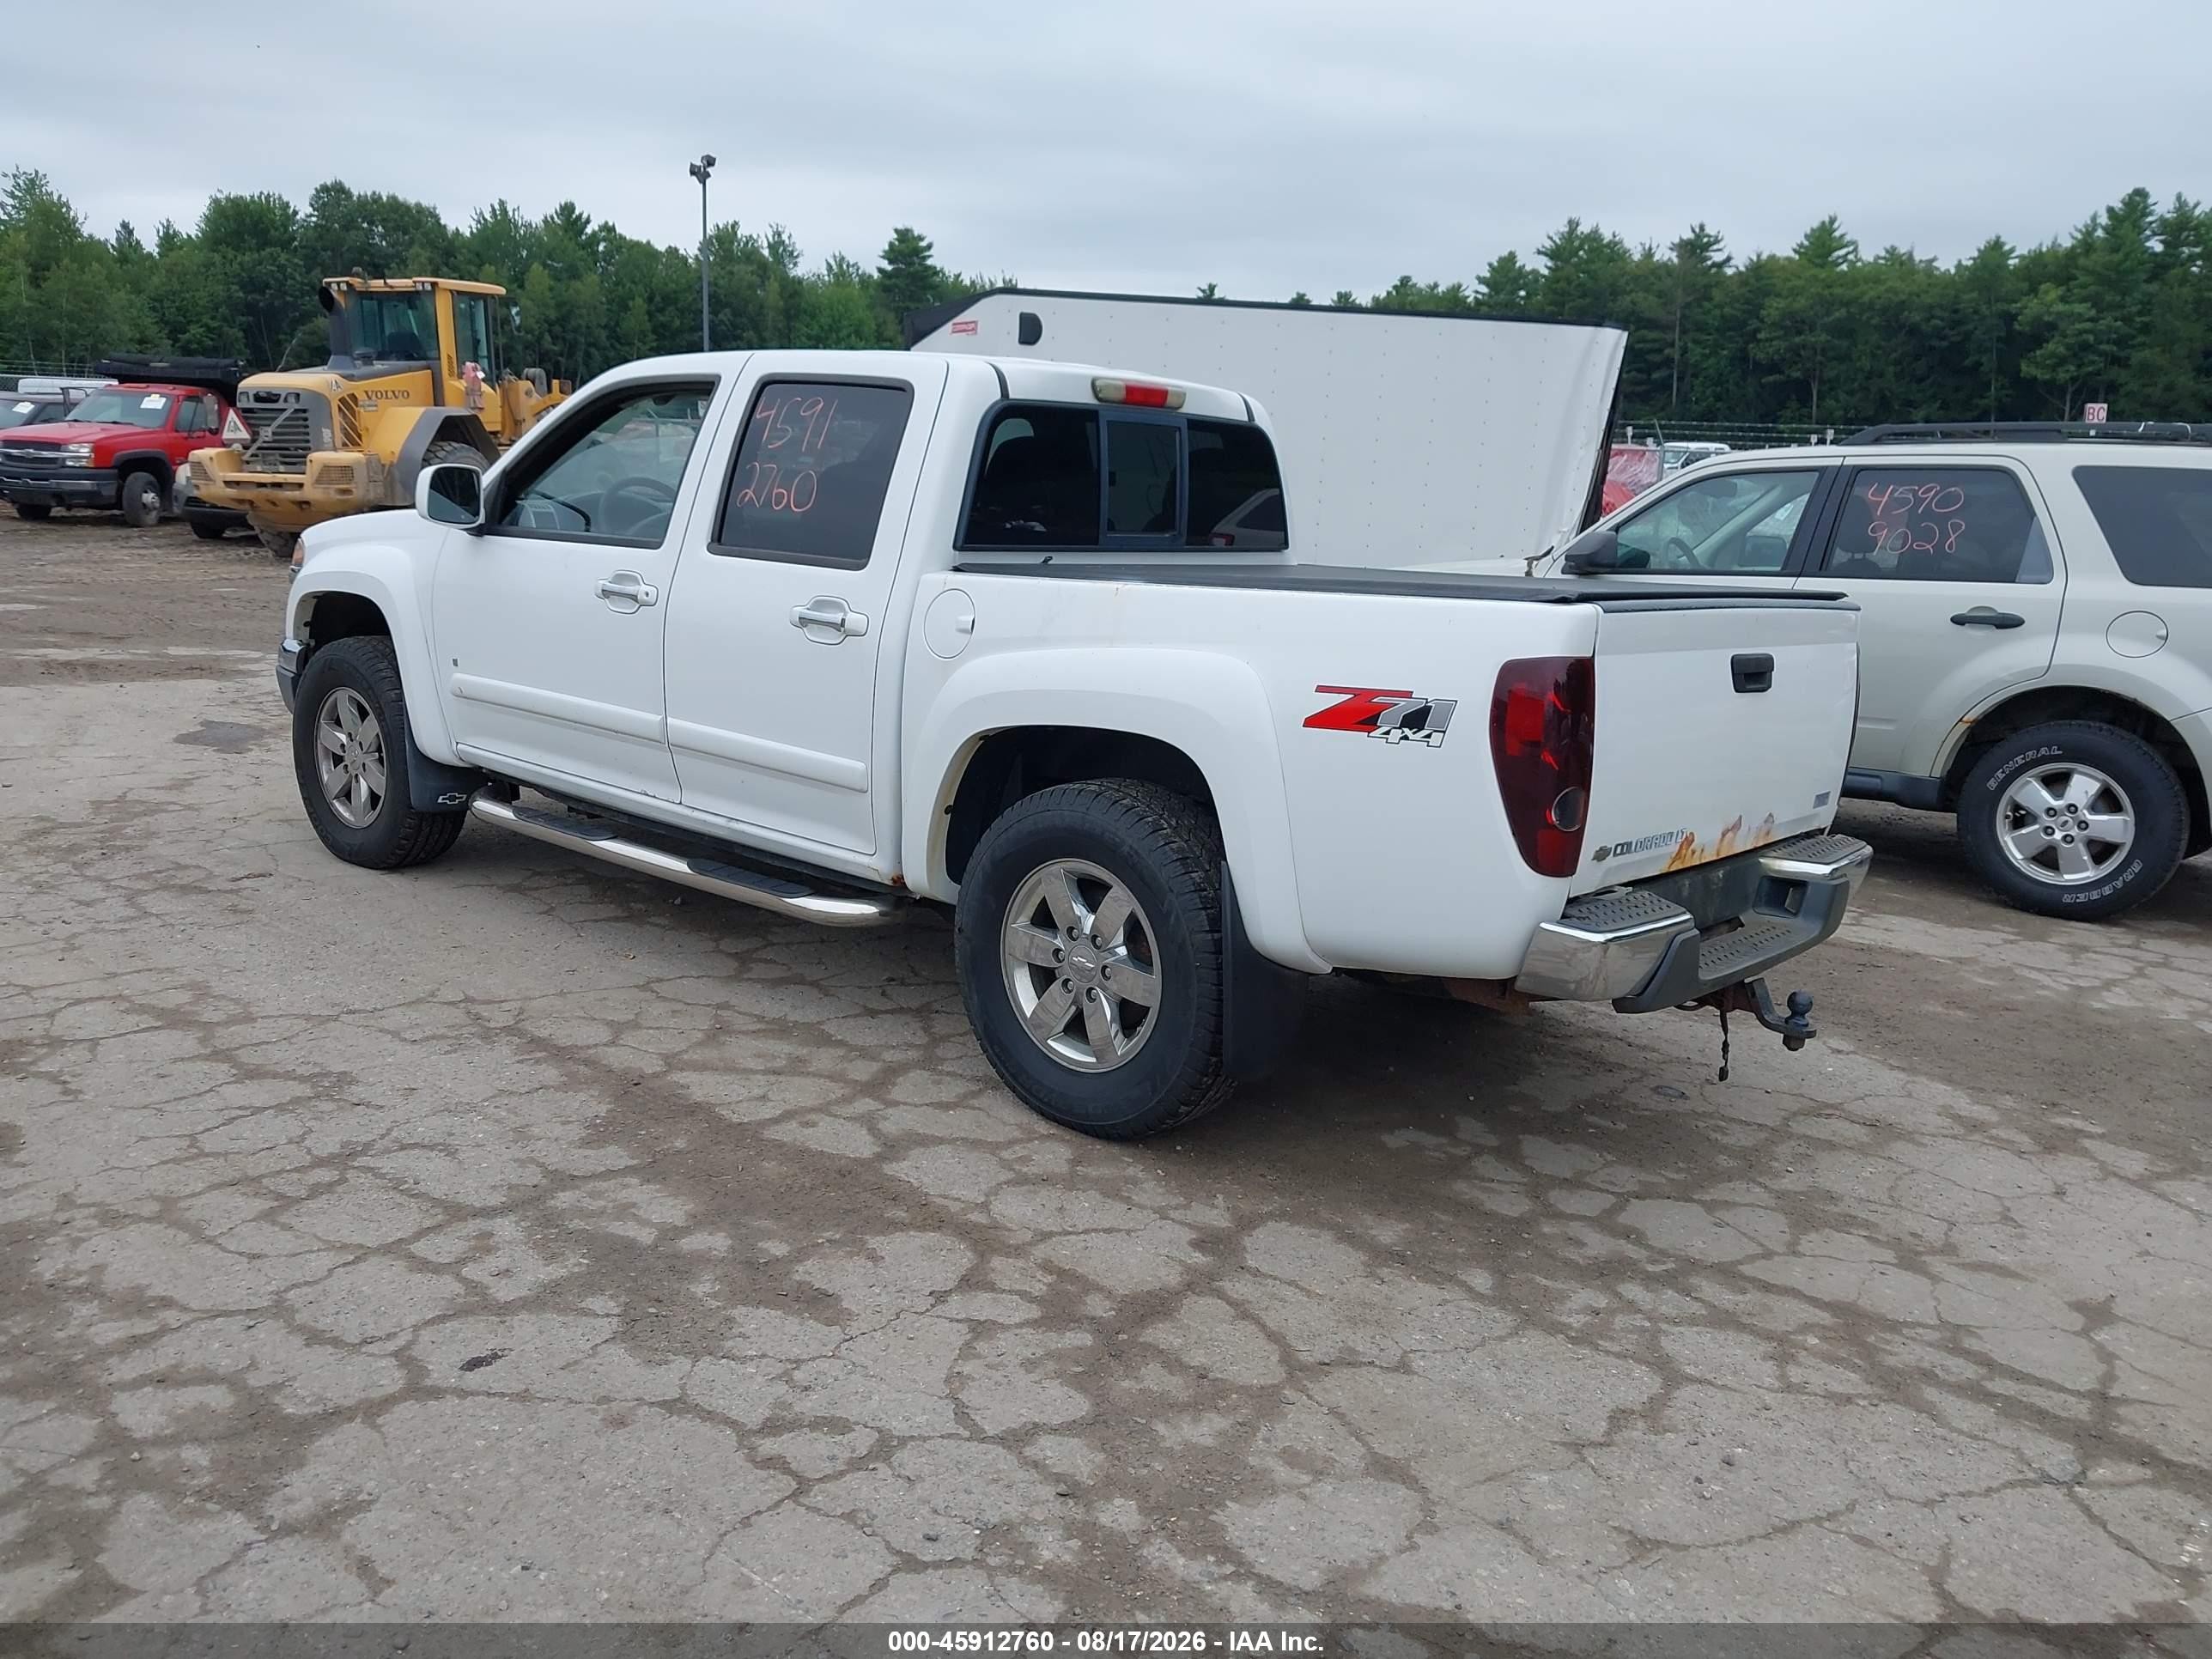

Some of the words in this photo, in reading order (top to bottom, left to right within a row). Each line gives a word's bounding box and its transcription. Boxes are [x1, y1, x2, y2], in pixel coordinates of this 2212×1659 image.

[363, 389, 410, 400] VOLVO
[2087, 406, 2106, 422] BC
[756, 396, 839, 453] 4591
[736, 461, 817, 513] 2760
[1868, 482, 1965, 516] 4590
[1868, 519, 1966, 556] 9028
[1302, 684, 1458, 733] Z71
[1986, 745, 2063, 791] GENERAL
[1613, 830, 1675, 858] COLORADO
[2062, 859, 2143, 903] GRABBER
